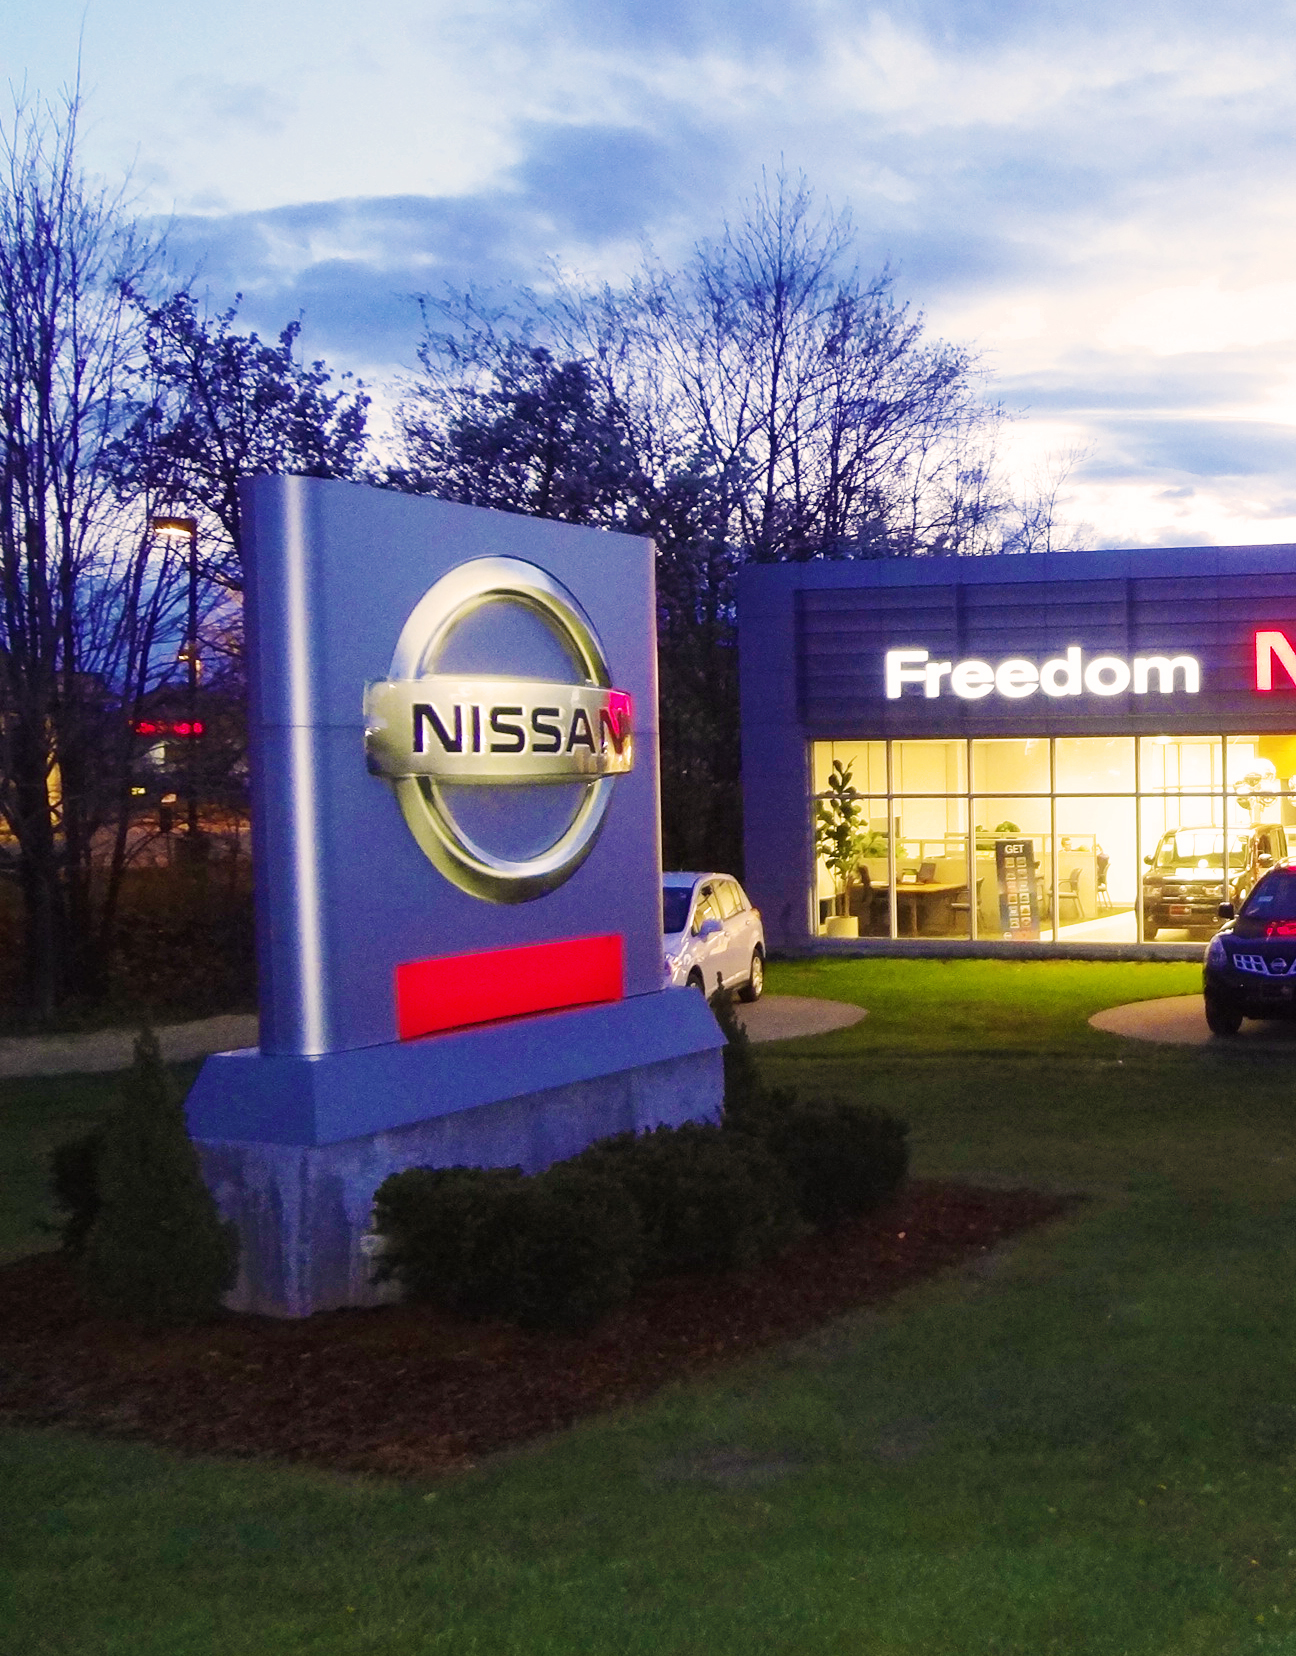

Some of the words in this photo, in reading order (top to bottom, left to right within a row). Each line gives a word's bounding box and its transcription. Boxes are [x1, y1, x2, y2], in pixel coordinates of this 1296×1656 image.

[885, 646, 1200, 699] Freedom
[412, 702, 628, 756] NISSAN
[1004, 844, 1025, 854] GET
